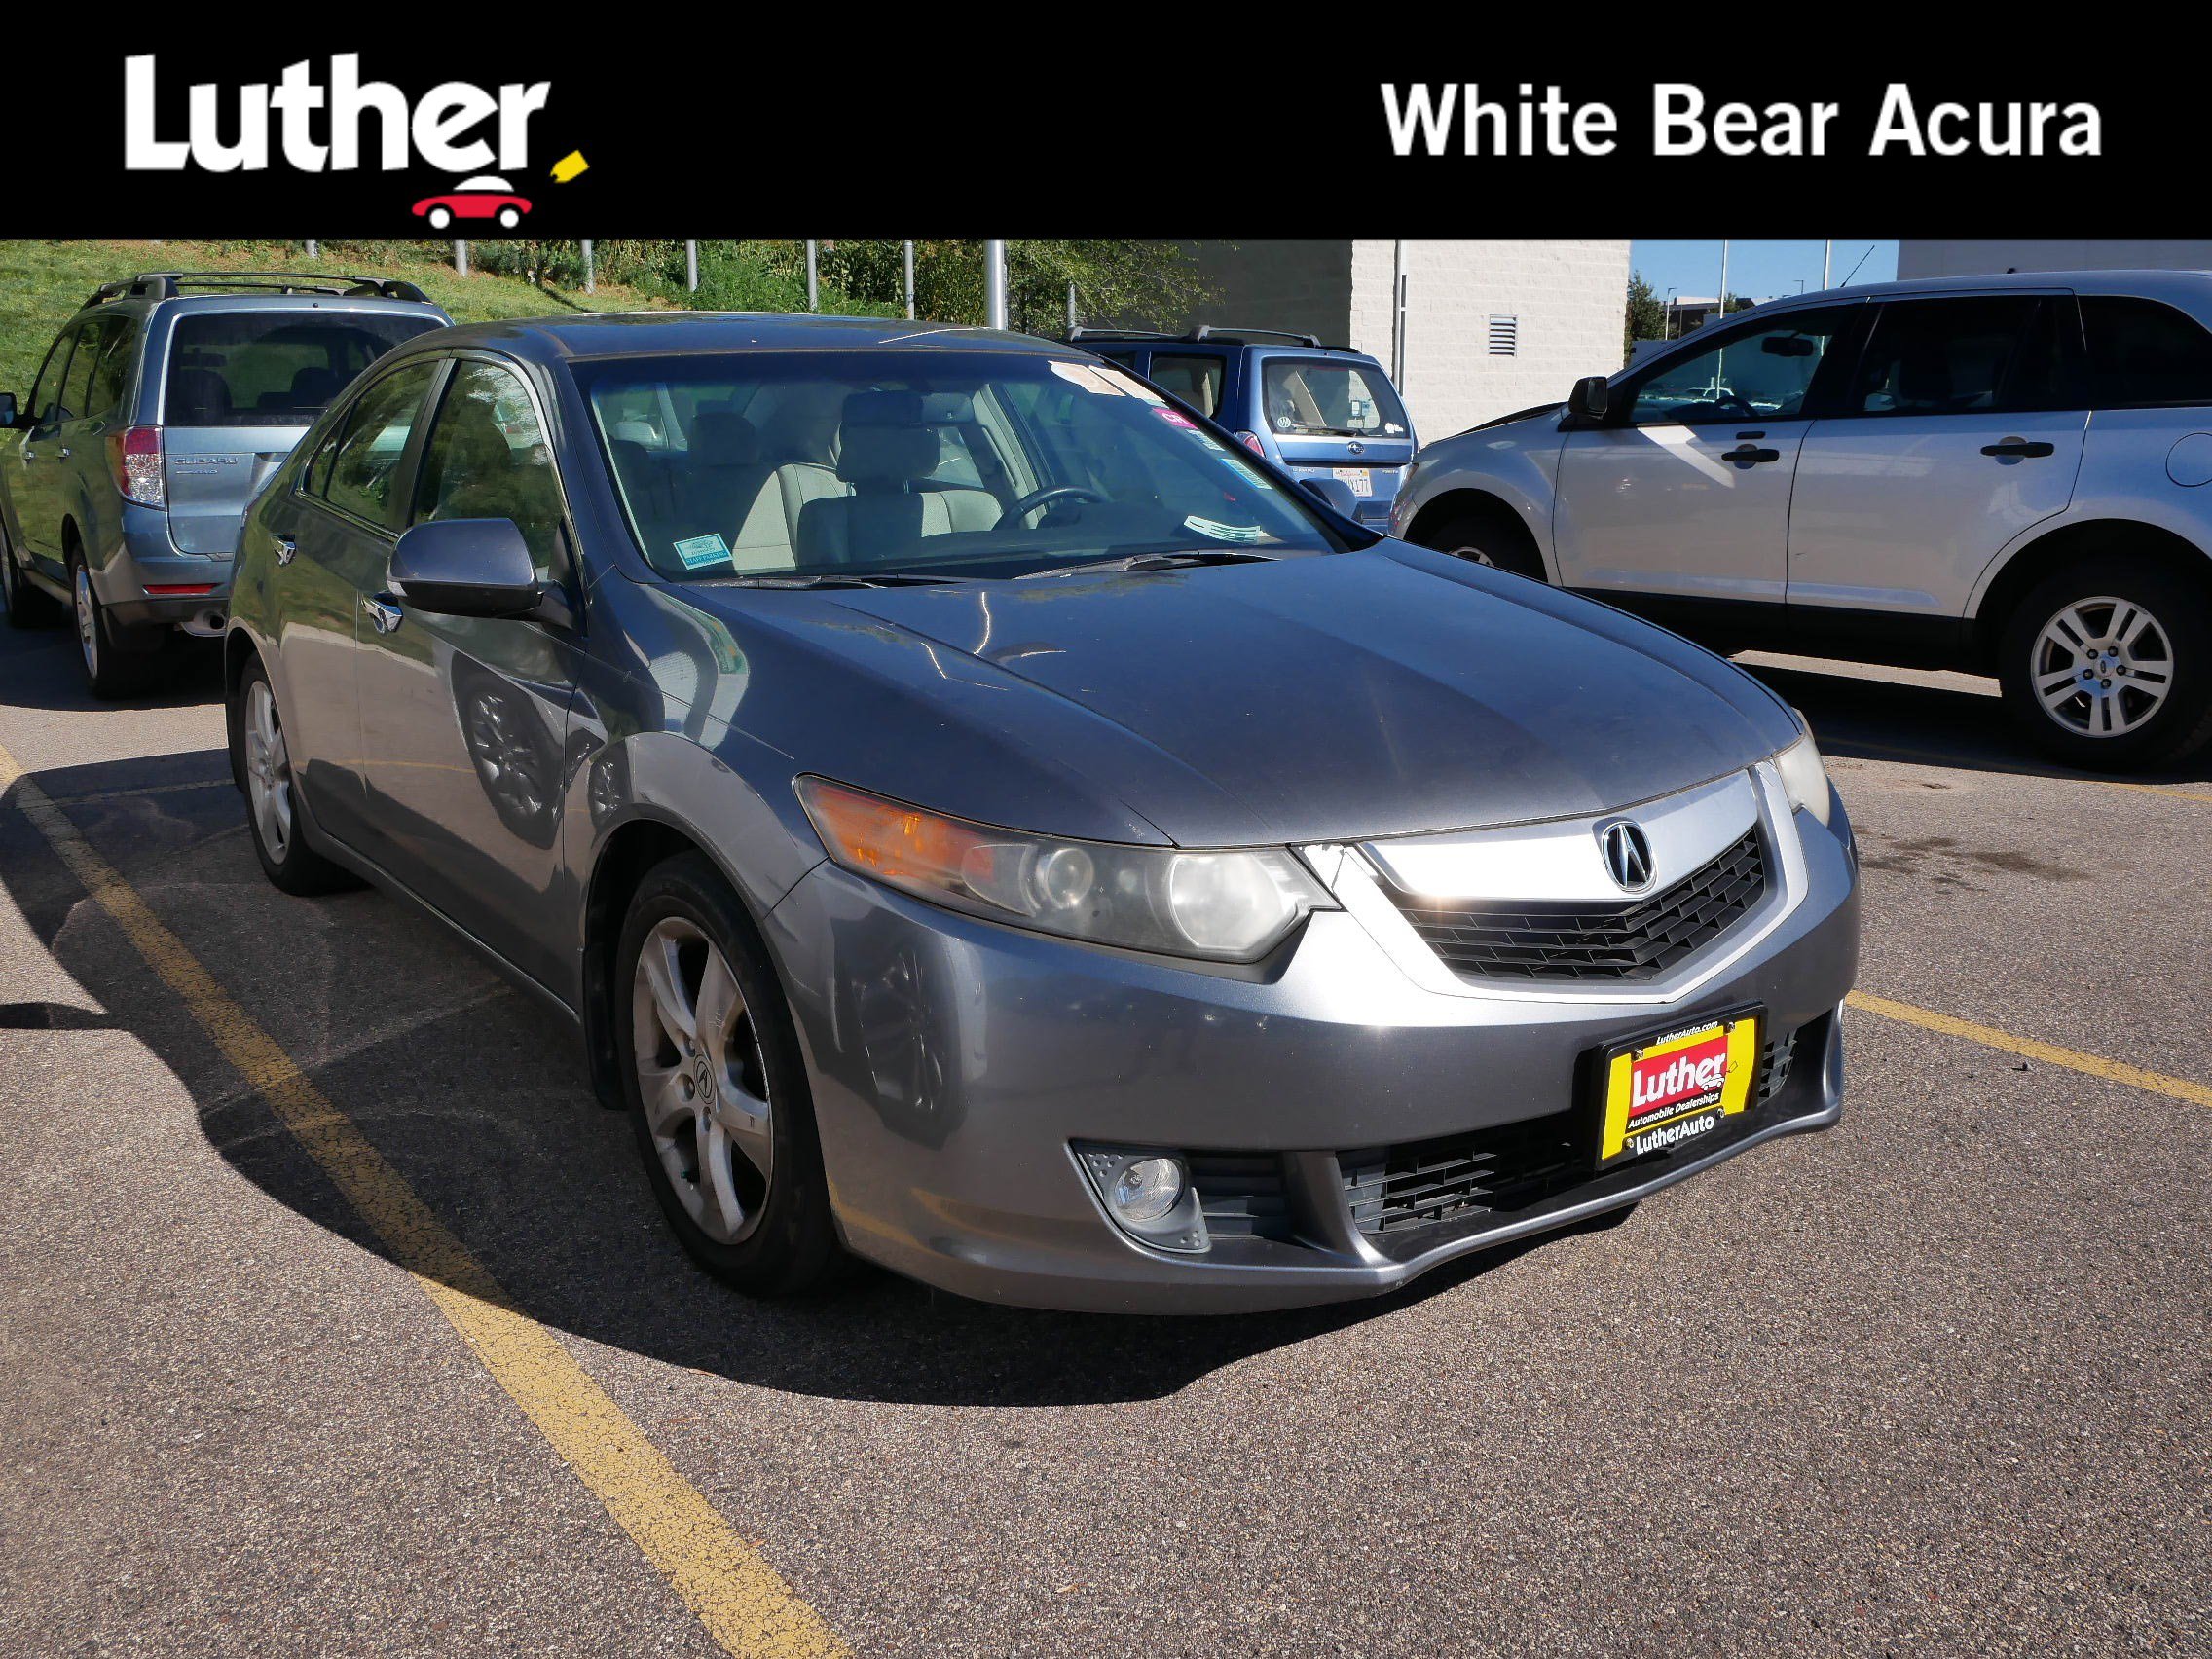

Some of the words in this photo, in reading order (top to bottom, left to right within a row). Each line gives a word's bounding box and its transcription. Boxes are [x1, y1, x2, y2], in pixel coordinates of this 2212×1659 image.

[175, 457, 239, 465] SUBARU
[1655, 1020, 1719, 1046] LutherAuto.com
[1632, 1052, 1726, 1108] Luther
[1628, 1106, 1675, 1129] Automobile
[1675, 1091, 1720, 1113] Dealerships
[1636, 1115, 1715, 1156] LutherAuto
